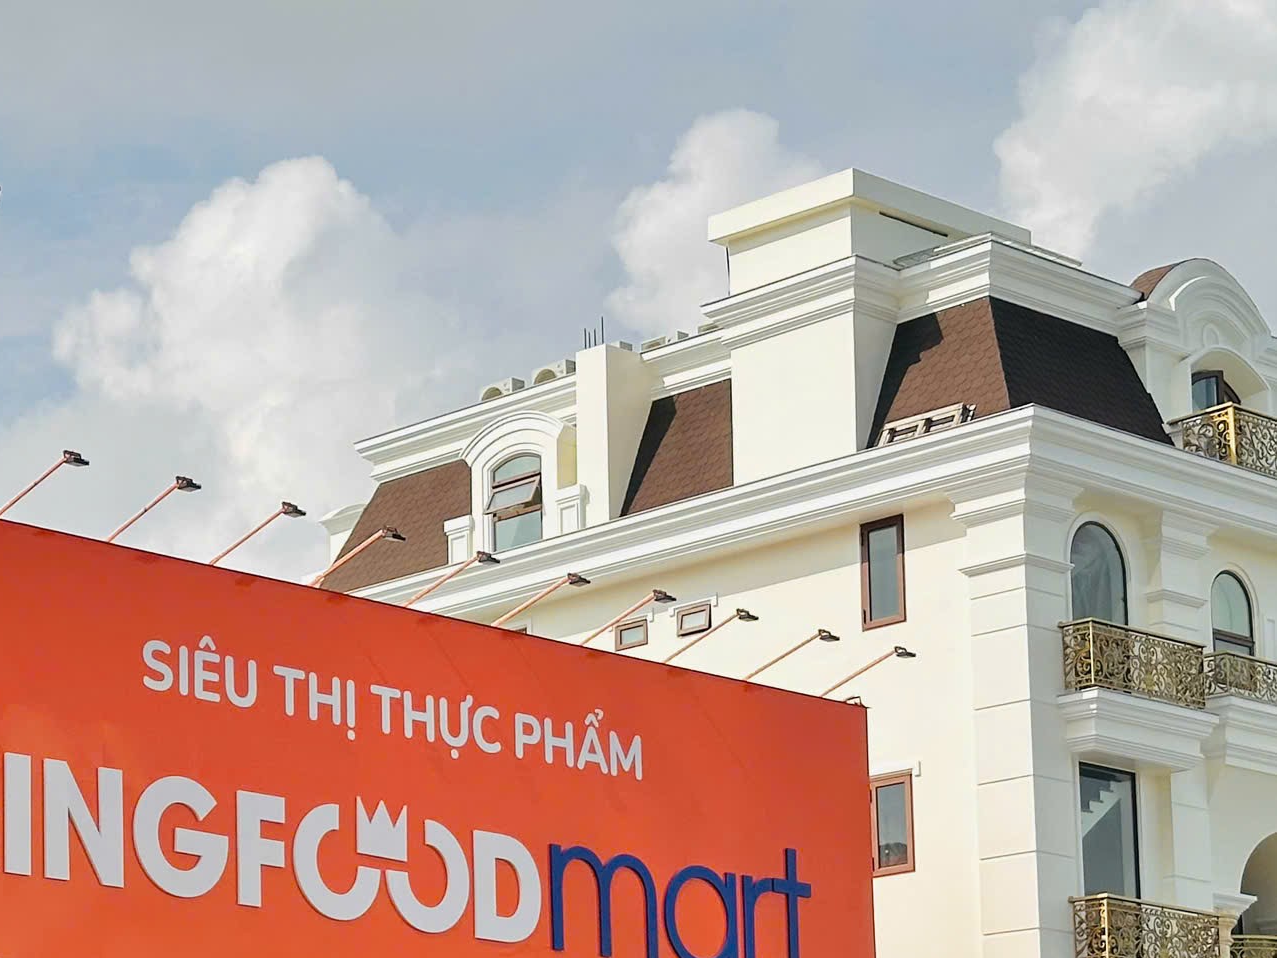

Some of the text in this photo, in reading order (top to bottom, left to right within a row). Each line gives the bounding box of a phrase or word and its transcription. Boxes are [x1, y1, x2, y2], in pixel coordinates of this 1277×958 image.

[141, 637, 644, 782] SIÊU THỊ THỰC PHẨM
